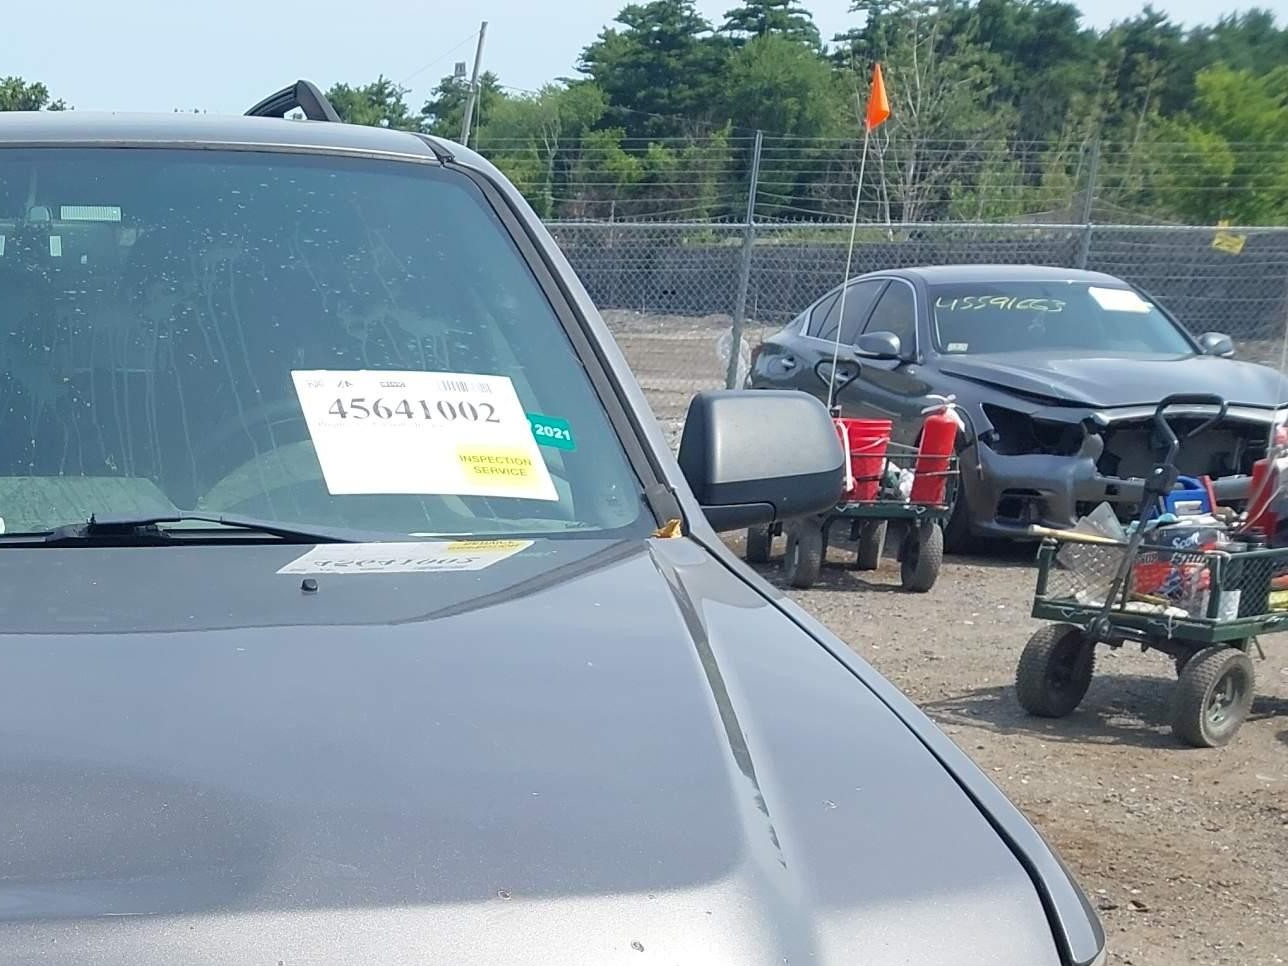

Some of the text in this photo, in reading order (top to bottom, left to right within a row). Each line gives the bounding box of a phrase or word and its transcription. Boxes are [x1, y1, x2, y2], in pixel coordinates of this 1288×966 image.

[328, 398, 500, 423] 45641002
[534, 423, 571, 441] 2021
[459, 454, 532, 466] INSPECTION
[473, 465, 528, 477] SERVICE
